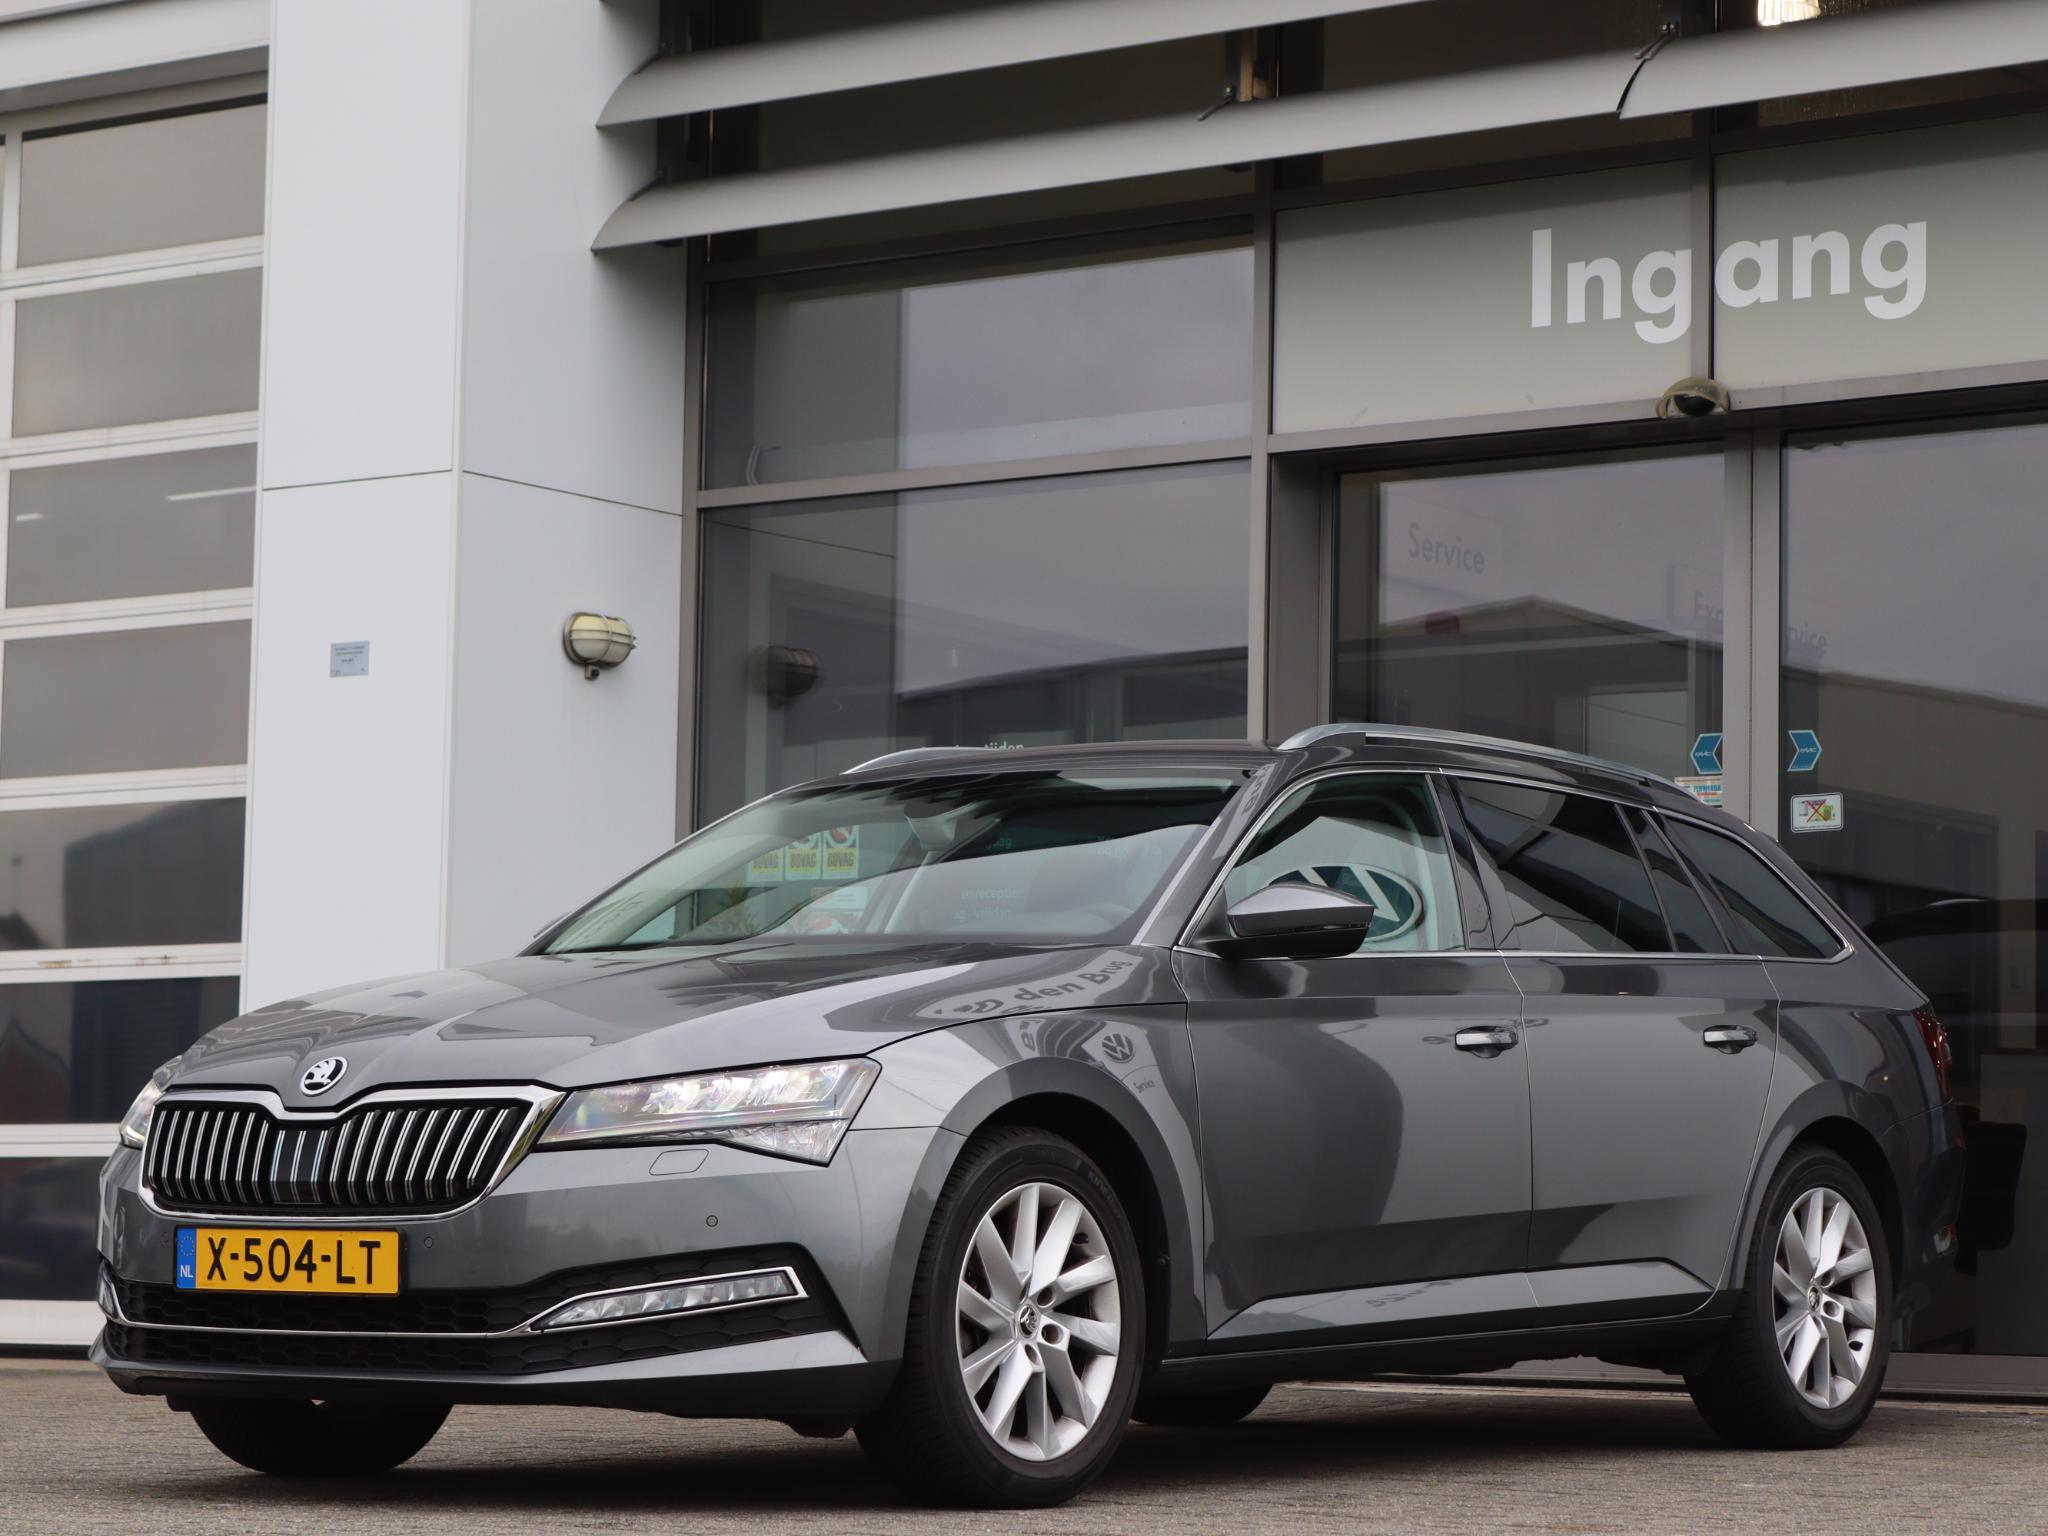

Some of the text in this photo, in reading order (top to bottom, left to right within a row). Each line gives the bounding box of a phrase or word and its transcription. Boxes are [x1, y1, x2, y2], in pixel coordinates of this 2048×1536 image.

[1530, 220, 1928, 344] Ingang
[1408, 521, 1485, 575] Service
[1013, 960, 1134, 1002] den Brug
[180, 1265, 194, 1278] NL
[206, 1236, 381, 1285] X-504-LT
